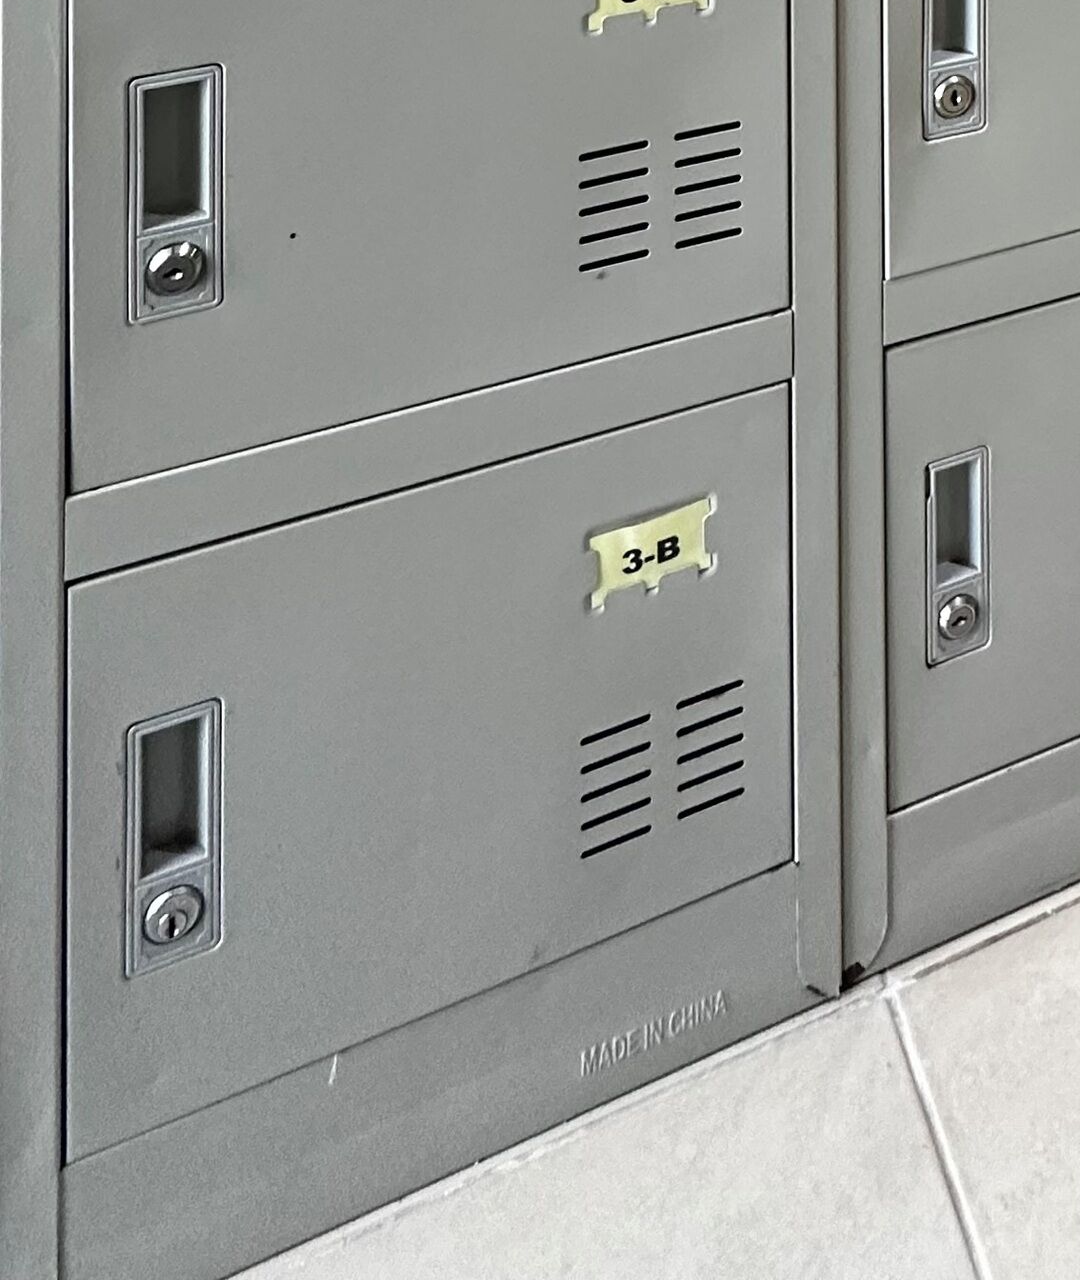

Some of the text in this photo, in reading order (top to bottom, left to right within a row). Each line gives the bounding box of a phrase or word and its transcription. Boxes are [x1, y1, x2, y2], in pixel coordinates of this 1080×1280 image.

[621, 535, 681, 575] 3-B
[580, 989, 728, 1077] MADE IN CHINA
